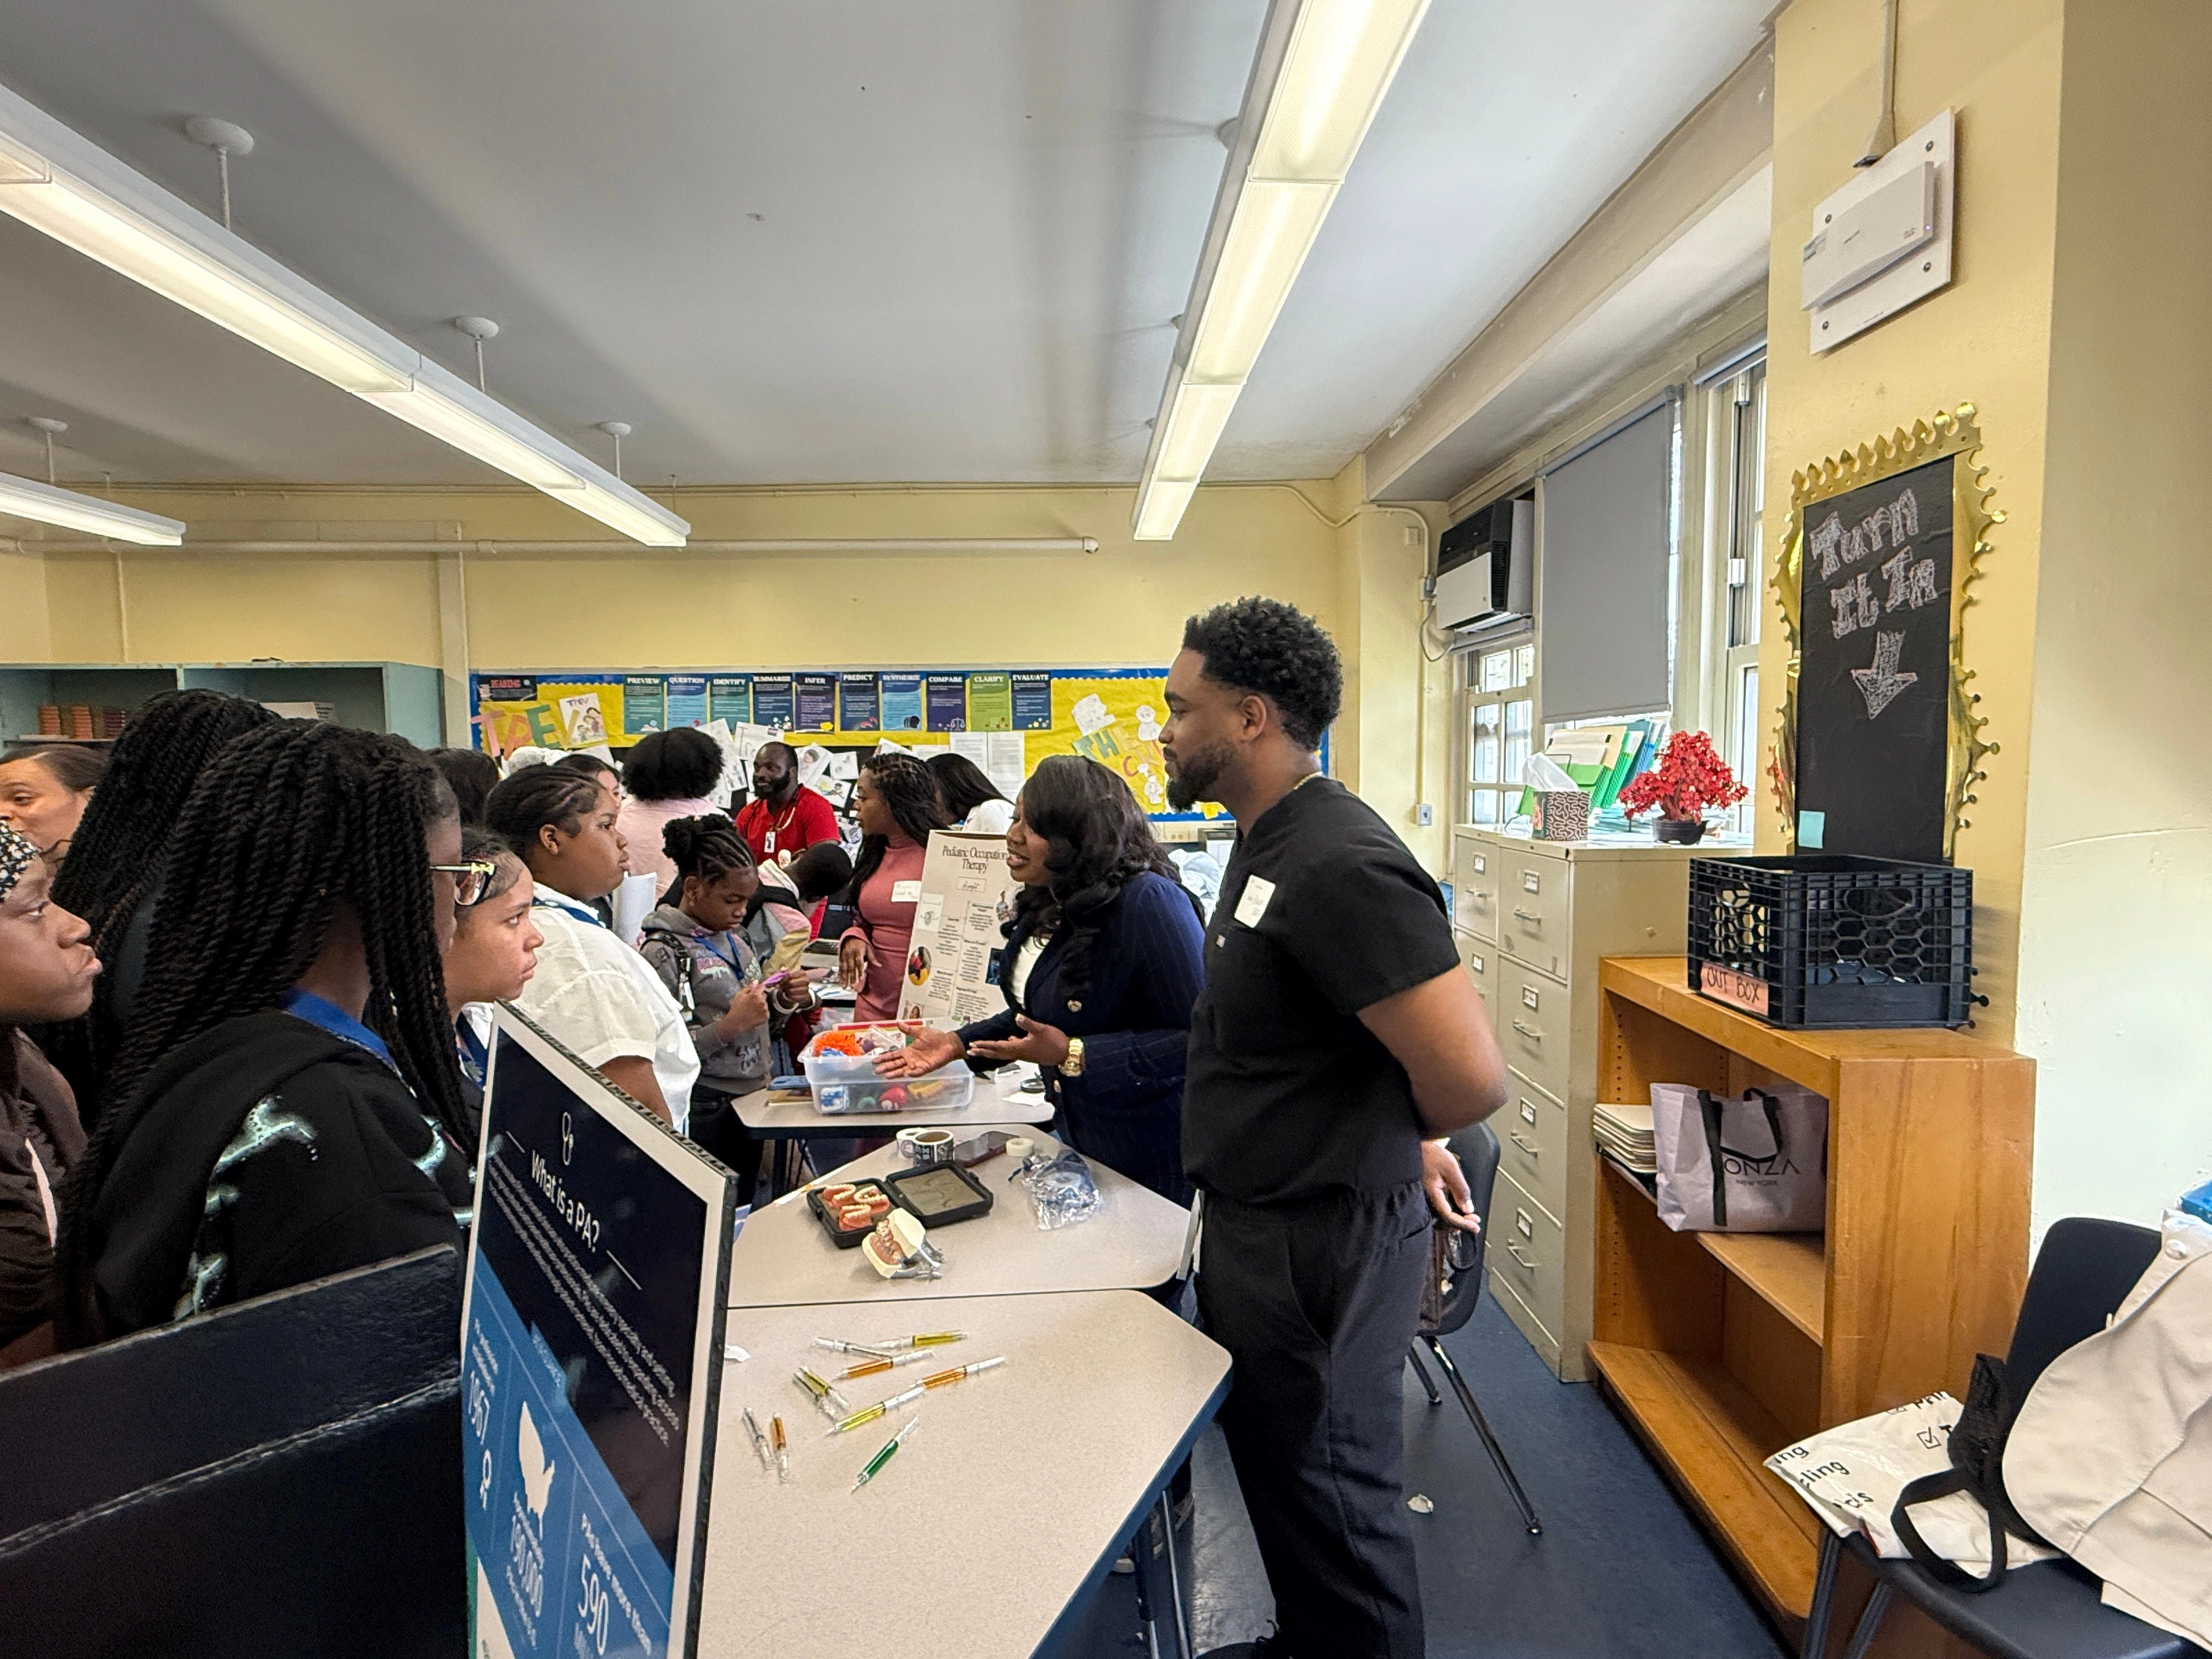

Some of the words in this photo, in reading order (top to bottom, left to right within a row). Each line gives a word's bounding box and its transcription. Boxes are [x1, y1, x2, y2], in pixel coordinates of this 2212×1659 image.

[1810, 488, 1919, 580] Turn
[1831, 572, 1879, 639] It
[1882, 545, 1938, 612] In
[713, 678, 746, 686] IDENTIFY
[962, 859, 988, 874] Therapy
[1707, 967, 1728, 990] OUT
[1736, 977, 1760, 1003] BOX
[531, 1149, 556, 1204] What
[556, 1178, 566, 1216] is
[566, 1204, 574, 1226] a
[575, 1201, 600, 1252] PA?
[578, 1554, 608, 1656] 590
